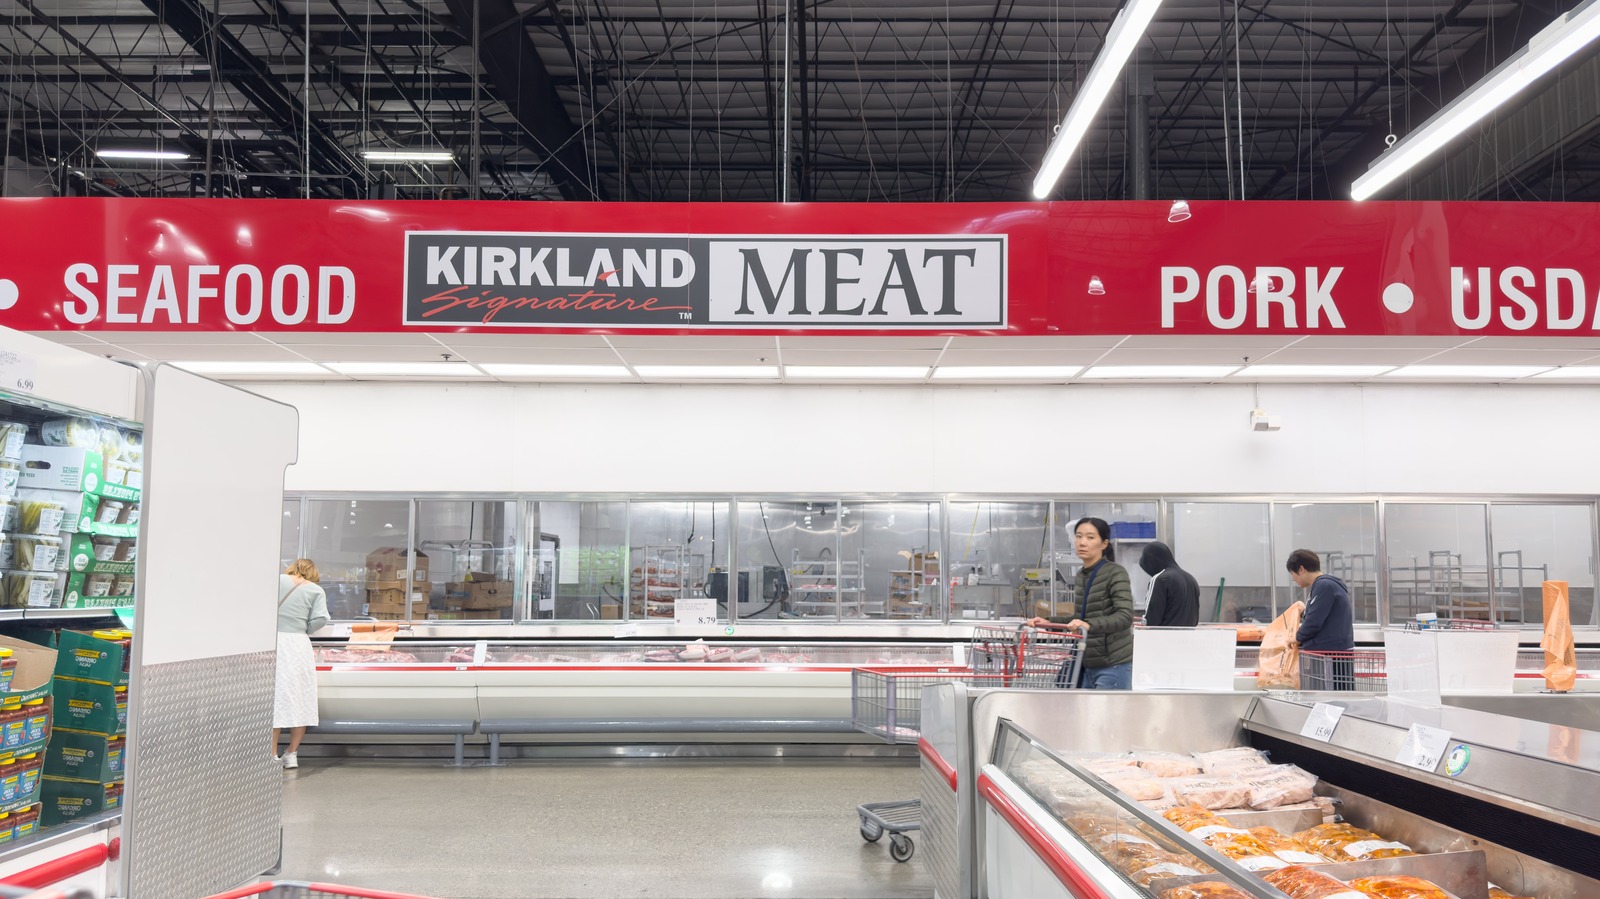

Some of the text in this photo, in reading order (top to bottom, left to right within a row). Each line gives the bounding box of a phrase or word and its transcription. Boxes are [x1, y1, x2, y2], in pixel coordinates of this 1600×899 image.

[426, 246, 696, 288] KIRKLAND
[734, 248, 977, 316] MEAT
[63, 264, 355, 325] SEAFOOD
[421, 285, 693, 323] Signature
[1162, 264, 1346, 330] PORK
[1450, 266, 1600, 331] USD
[678, 312, 692, 320] TM
[17, 378, 34, 390] 6.99
[698, 616, 716, 624] 8.79
[1314, 726, 1332, 737] 15.99
